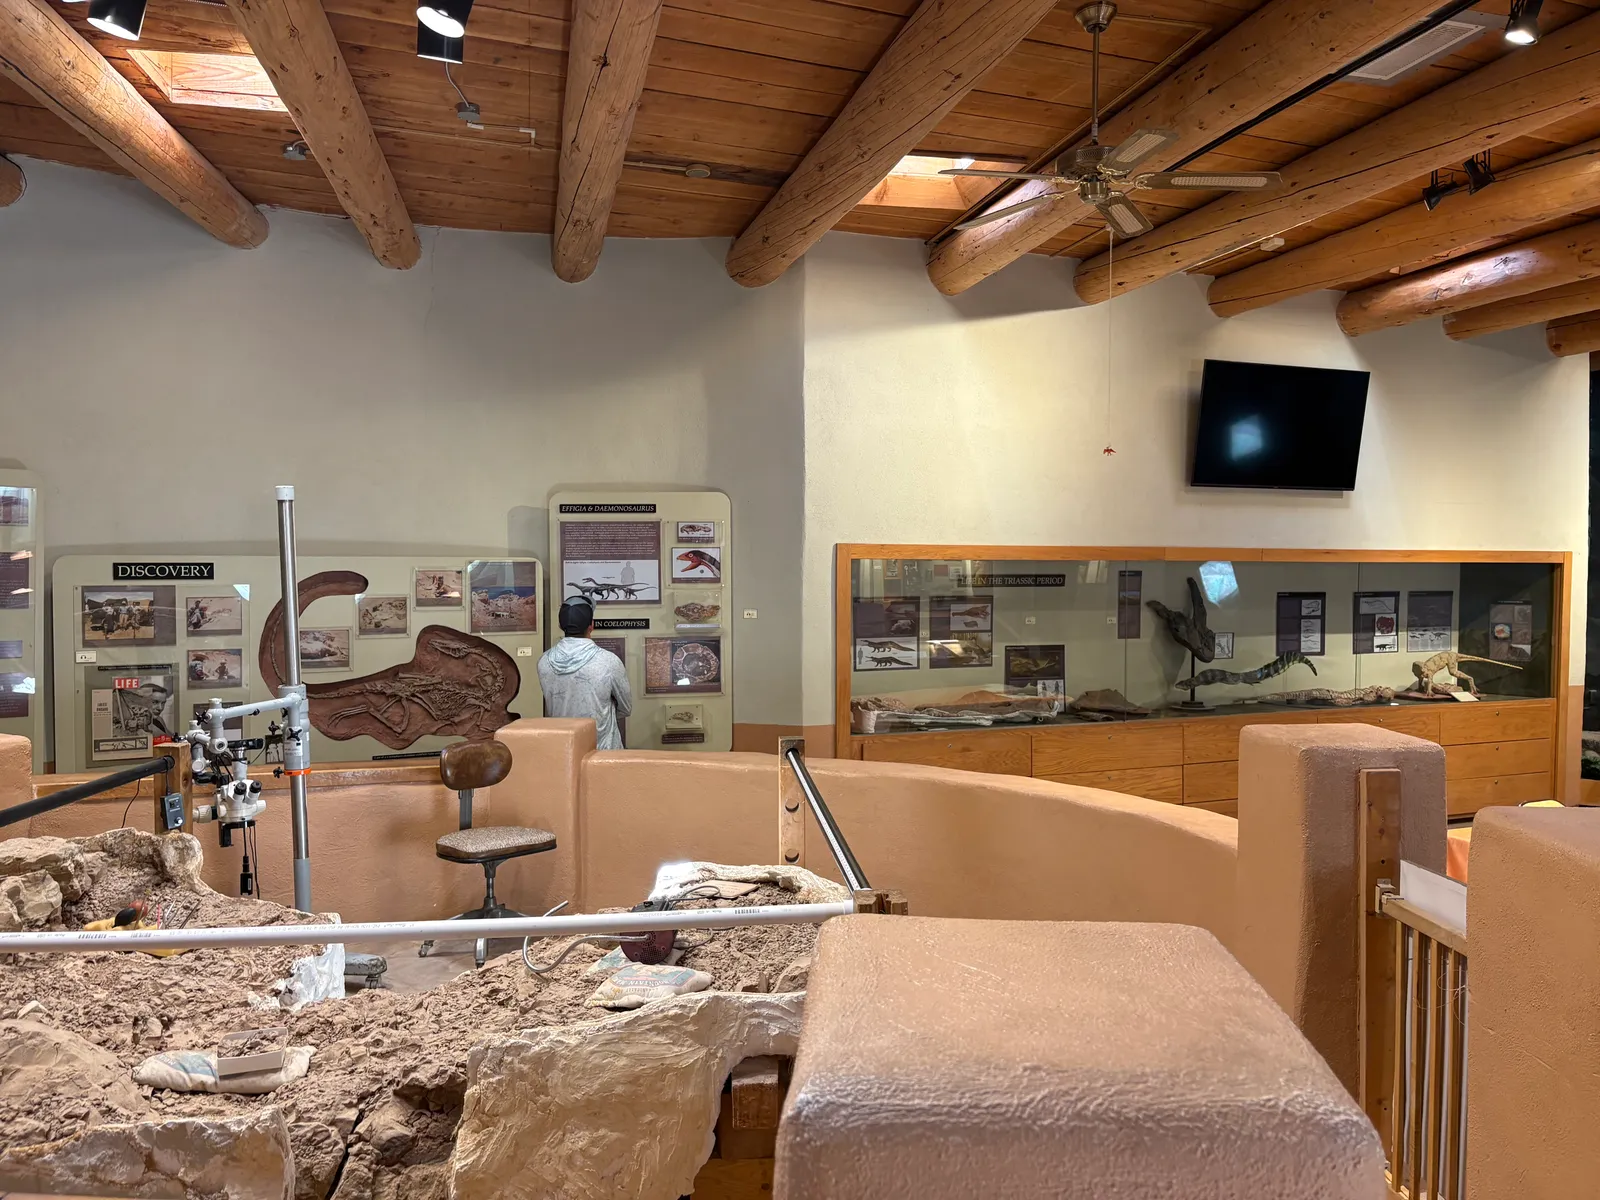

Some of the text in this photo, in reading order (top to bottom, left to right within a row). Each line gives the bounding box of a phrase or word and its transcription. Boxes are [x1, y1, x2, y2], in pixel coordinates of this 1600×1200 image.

[117, 564, 211, 577] DISCOVERY
[978, 577, 986, 585] IN
[988, 577, 1002, 585] THE
[1003, 577, 1036, 585] TRIASSIC
[1037, 577, 1063, 585] PERIOD
[115, 679, 138, 689] LIFE
